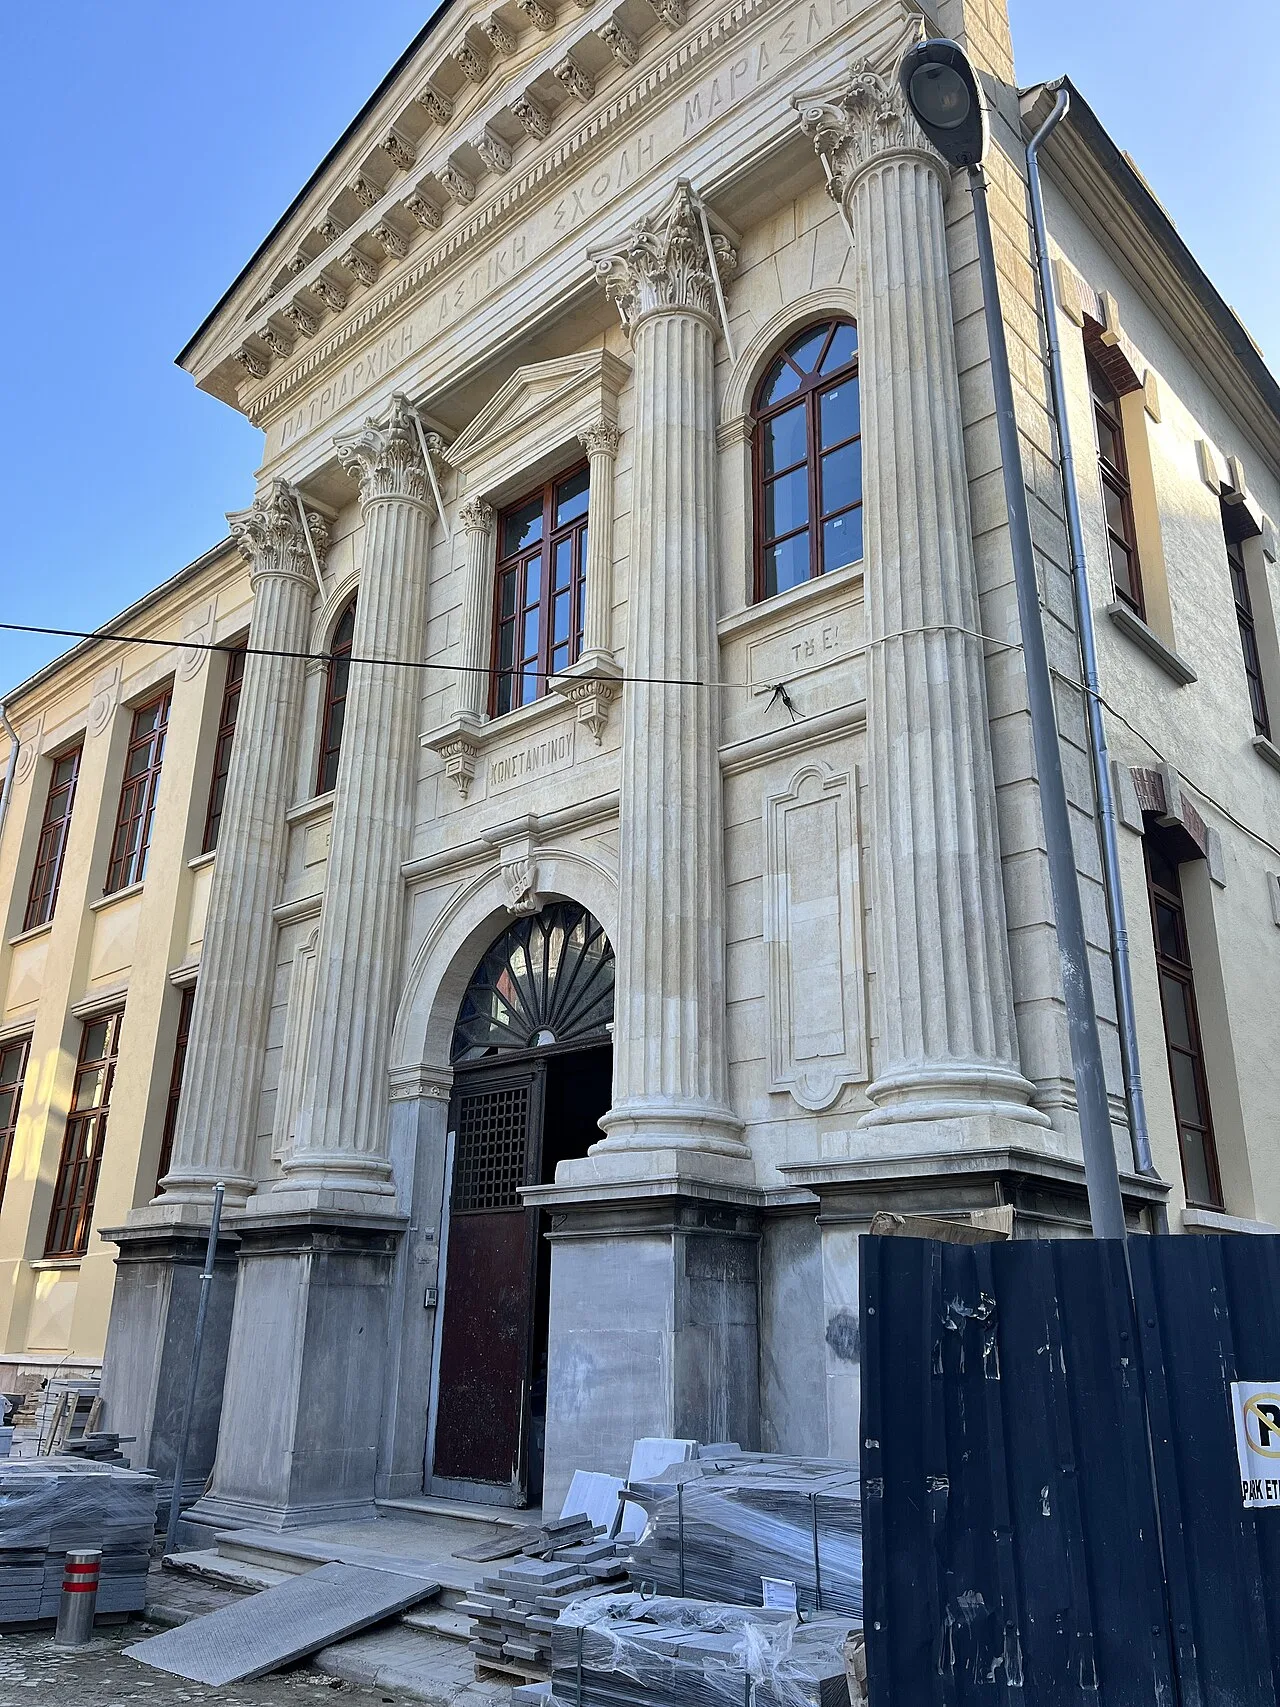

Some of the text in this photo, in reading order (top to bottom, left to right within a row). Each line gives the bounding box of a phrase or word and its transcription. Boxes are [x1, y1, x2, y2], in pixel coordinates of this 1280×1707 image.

[280, 325, 414, 447] ΠΑΤΡΙΑΡΧΙΚΗ
[438, 236, 526, 327] ΑΣΤΙΚΗ
[554, 134, 654, 231] ΣΧΟΛΗ
[491, 733, 572, 786] ΚΩΝΣΤΑΝΤΙΝΟΥ
[1265, 1479, 1280, 1500] ET
